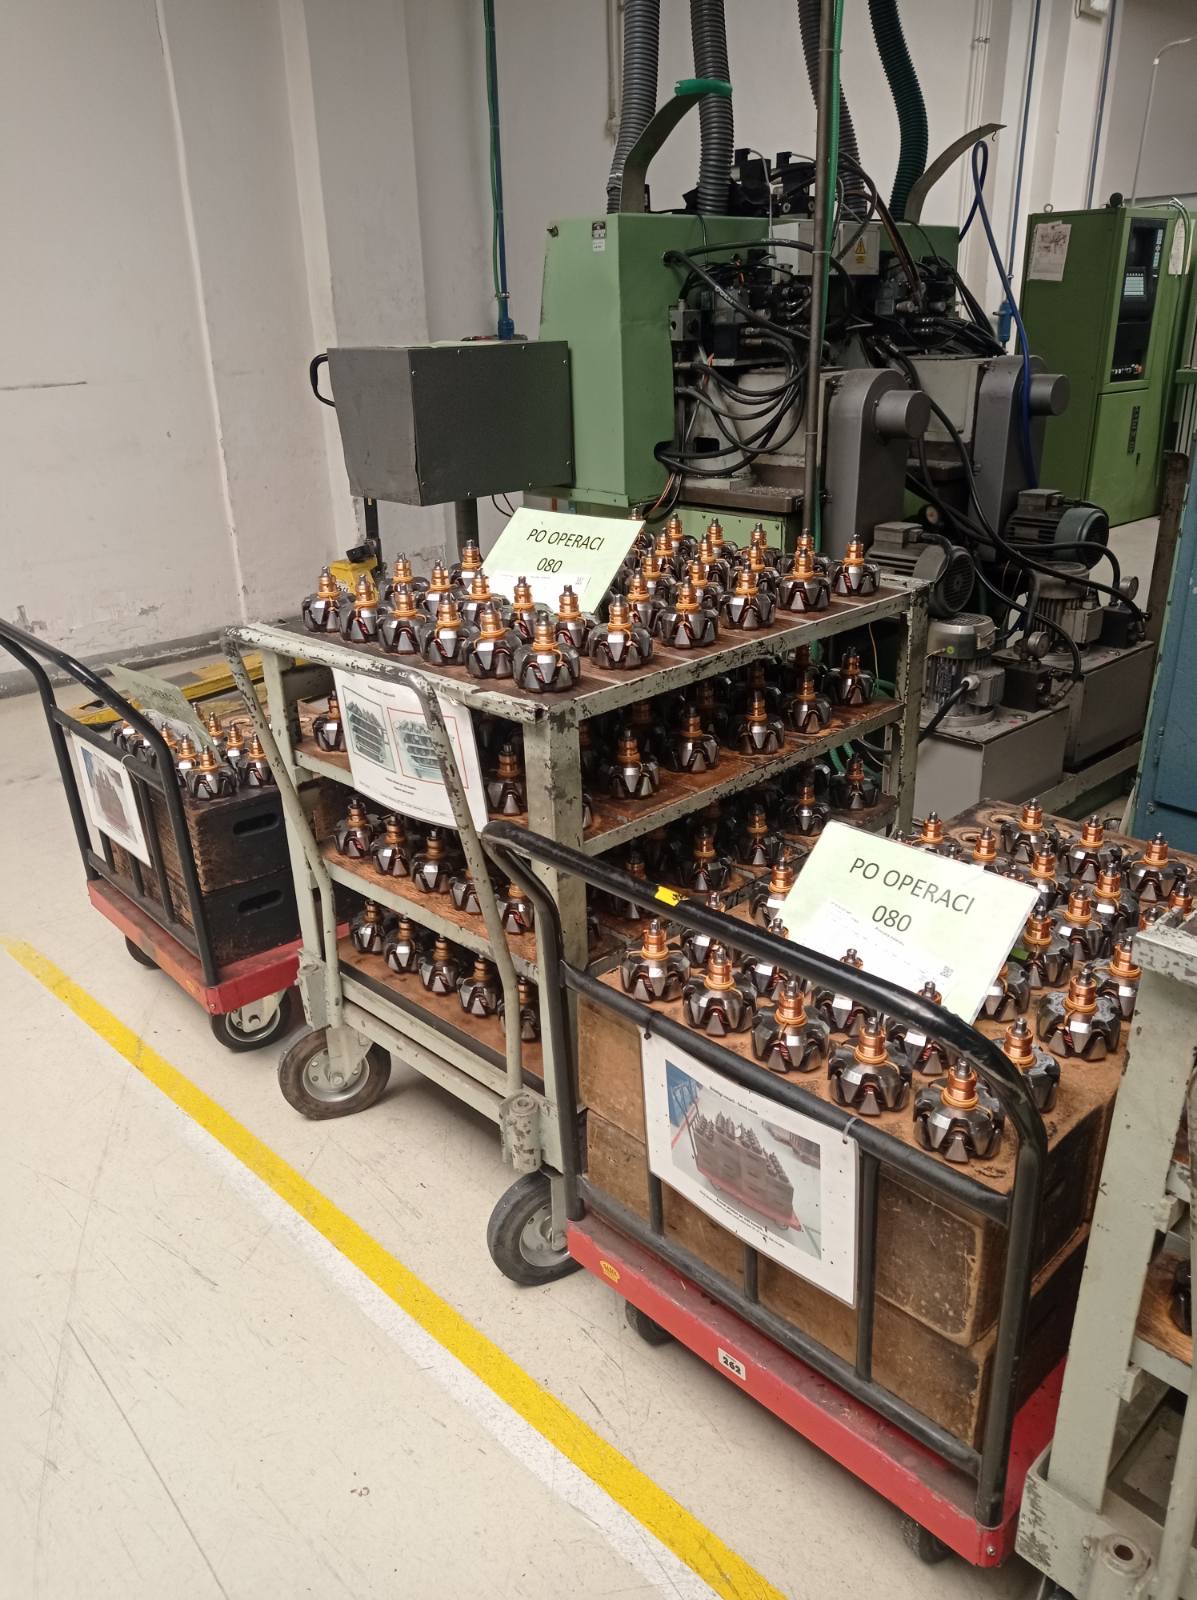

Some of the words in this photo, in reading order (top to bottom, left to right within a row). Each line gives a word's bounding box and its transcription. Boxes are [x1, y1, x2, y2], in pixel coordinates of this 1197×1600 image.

[526, 528, 547, 543] PO
[547, 531, 605, 551] OPERACI
[536, 557, 563, 573] 080
[849, 857, 880, 880] PO
[882, 869, 976, 915] OPERACI
[871, 904, 912, 932] 080
[722, 1355, 742, 1376] 262
